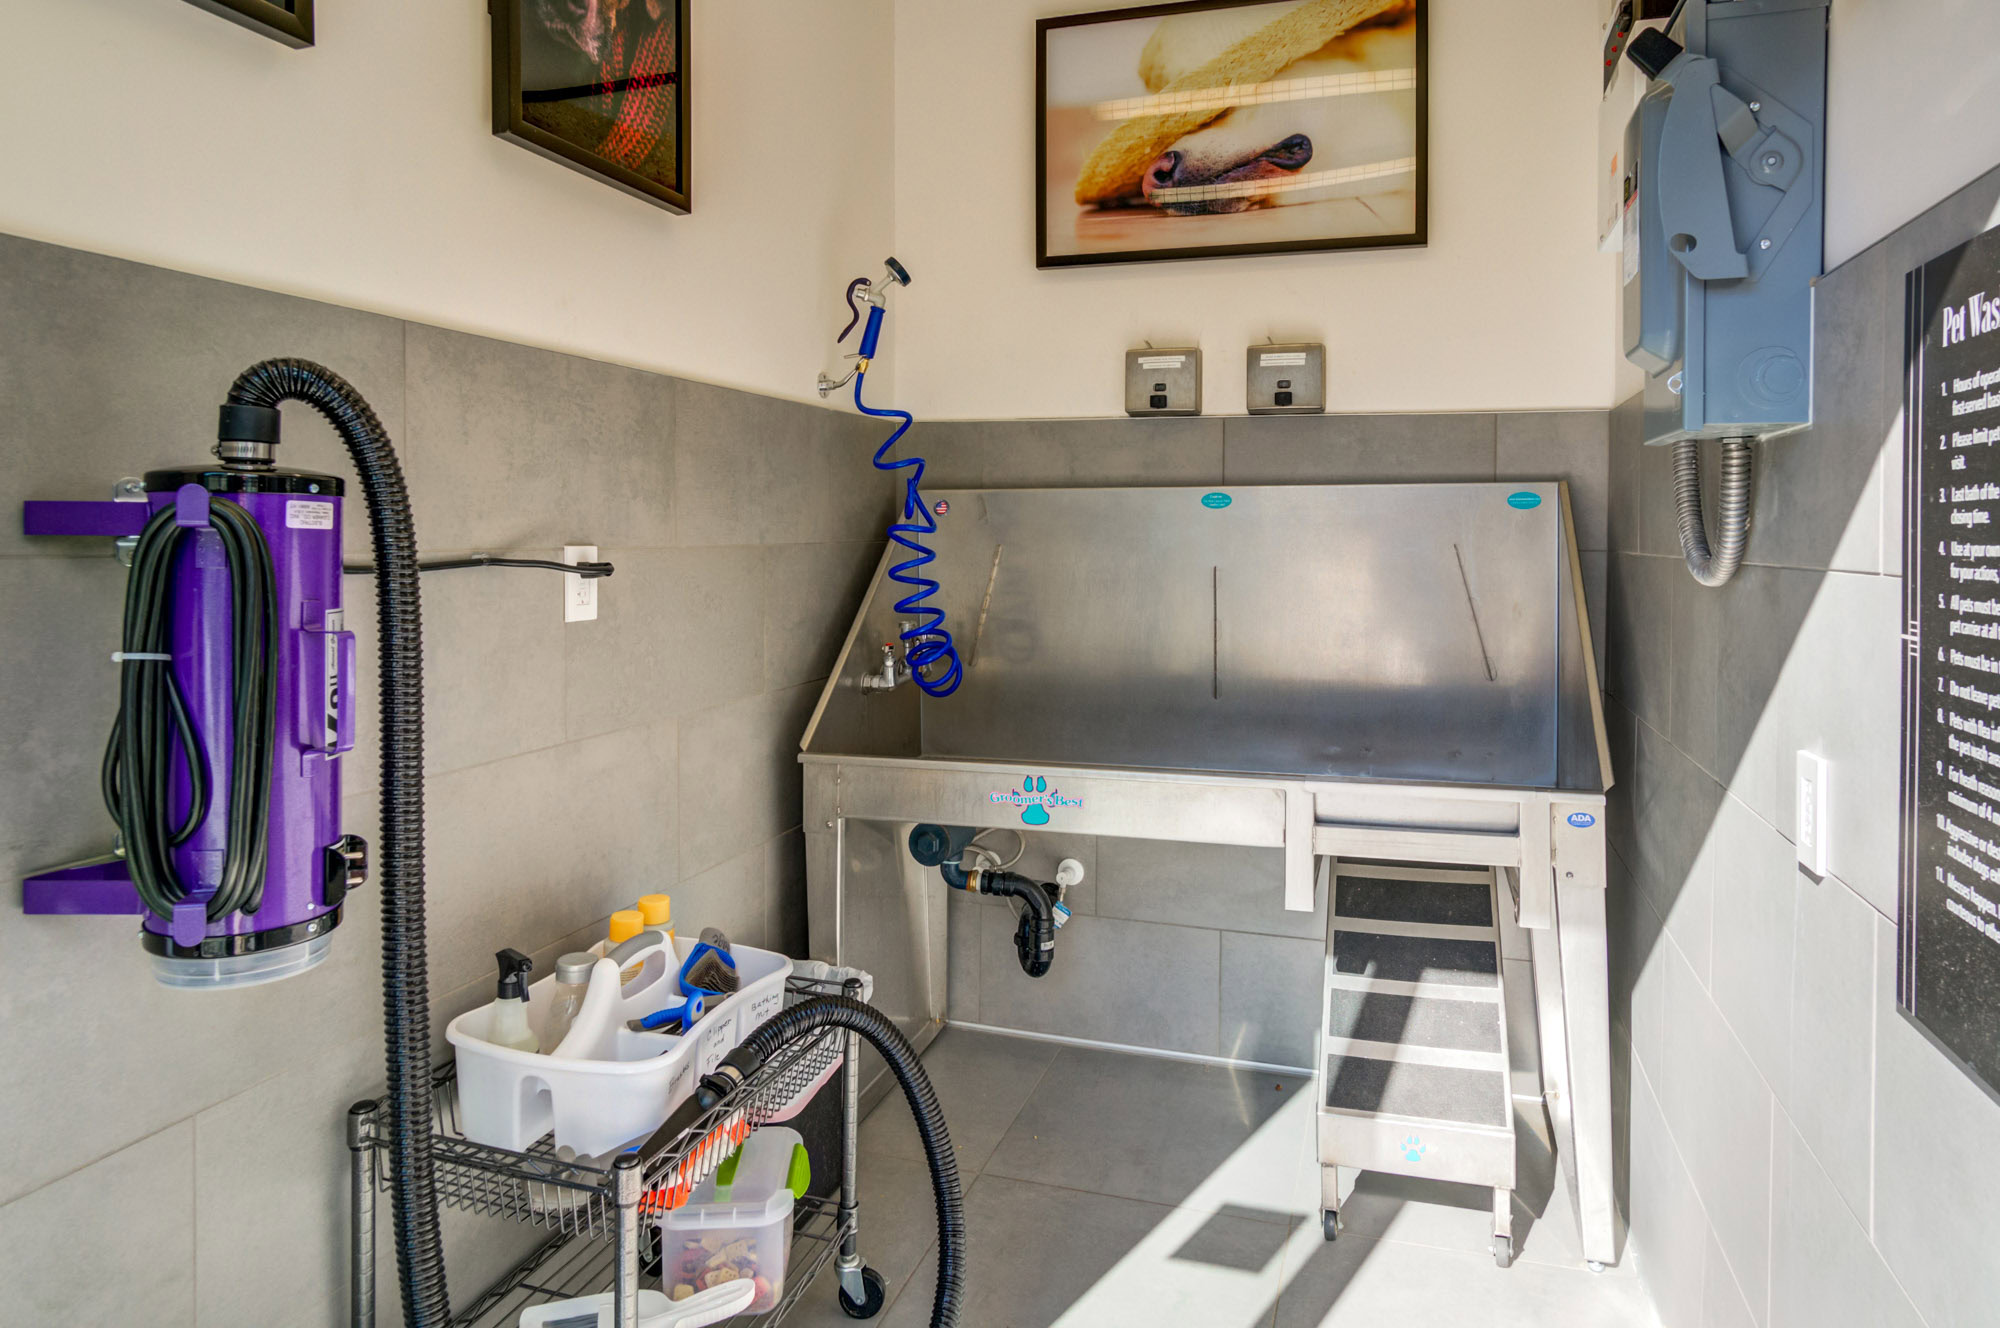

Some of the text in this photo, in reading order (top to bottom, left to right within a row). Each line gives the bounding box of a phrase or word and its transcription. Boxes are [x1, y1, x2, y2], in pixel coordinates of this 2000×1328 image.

[1942, 291, 2000, 348] Pet Was
[1953, 378, 1973, 394] Hours
[1973, 370, 1981, 389] of
[1952, 431, 1973, 448] Please
[1951, 487, 1964, 502] Last
[1964, 484, 1979, 501] bath
[1980, 483, 1988, 500] of
[1988, 483, 2000, 500] the
[1950, 508, 1973, 528] closing
[1951, 541, 1963, 556] Use
[1963, 543, 1970, 556] at
[1970, 545, 1985, 562] your
[1950, 562, 1960, 579] for
[1959, 567, 1974, 583] your
[1959, 598, 1973, 615] pets
[1973, 600, 1991, 615] must
[1949, 620, 1961, 636] pet
[1950, 649, 1964, 666] Pets
[1964, 655, 1981, 670] must
[1980, 654, 1990, 672] be
[1949, 680, 1960, 697] Do
[1959, 686, 1970, 700] not
[1970, 684, 1988, 705] leave
[1949, 712, 1963, 730] Pets
[1963, 718, 1977, 735] with
[1949, 734, 1960, 751] the
[1959, 741, 1970, 757] pet
[1970, 745, 1988, 762] wash
[1949, 765, 1960, 783] For
[989, 791, 1085, 808] Groomer's Best
[1571, 814, 1592, 822] ADA
[1978, 802, 1986, 818] of
[1946, 818, 1979, 849] Aggressive
[1947, 841, 1973, 869] includes
[1973, 856, 1990, 881] dogs
[1947, 872, 1971, 900] Messes
[1977, 916, 1985, 933] to
[713, 1034, 725, 1048] and
